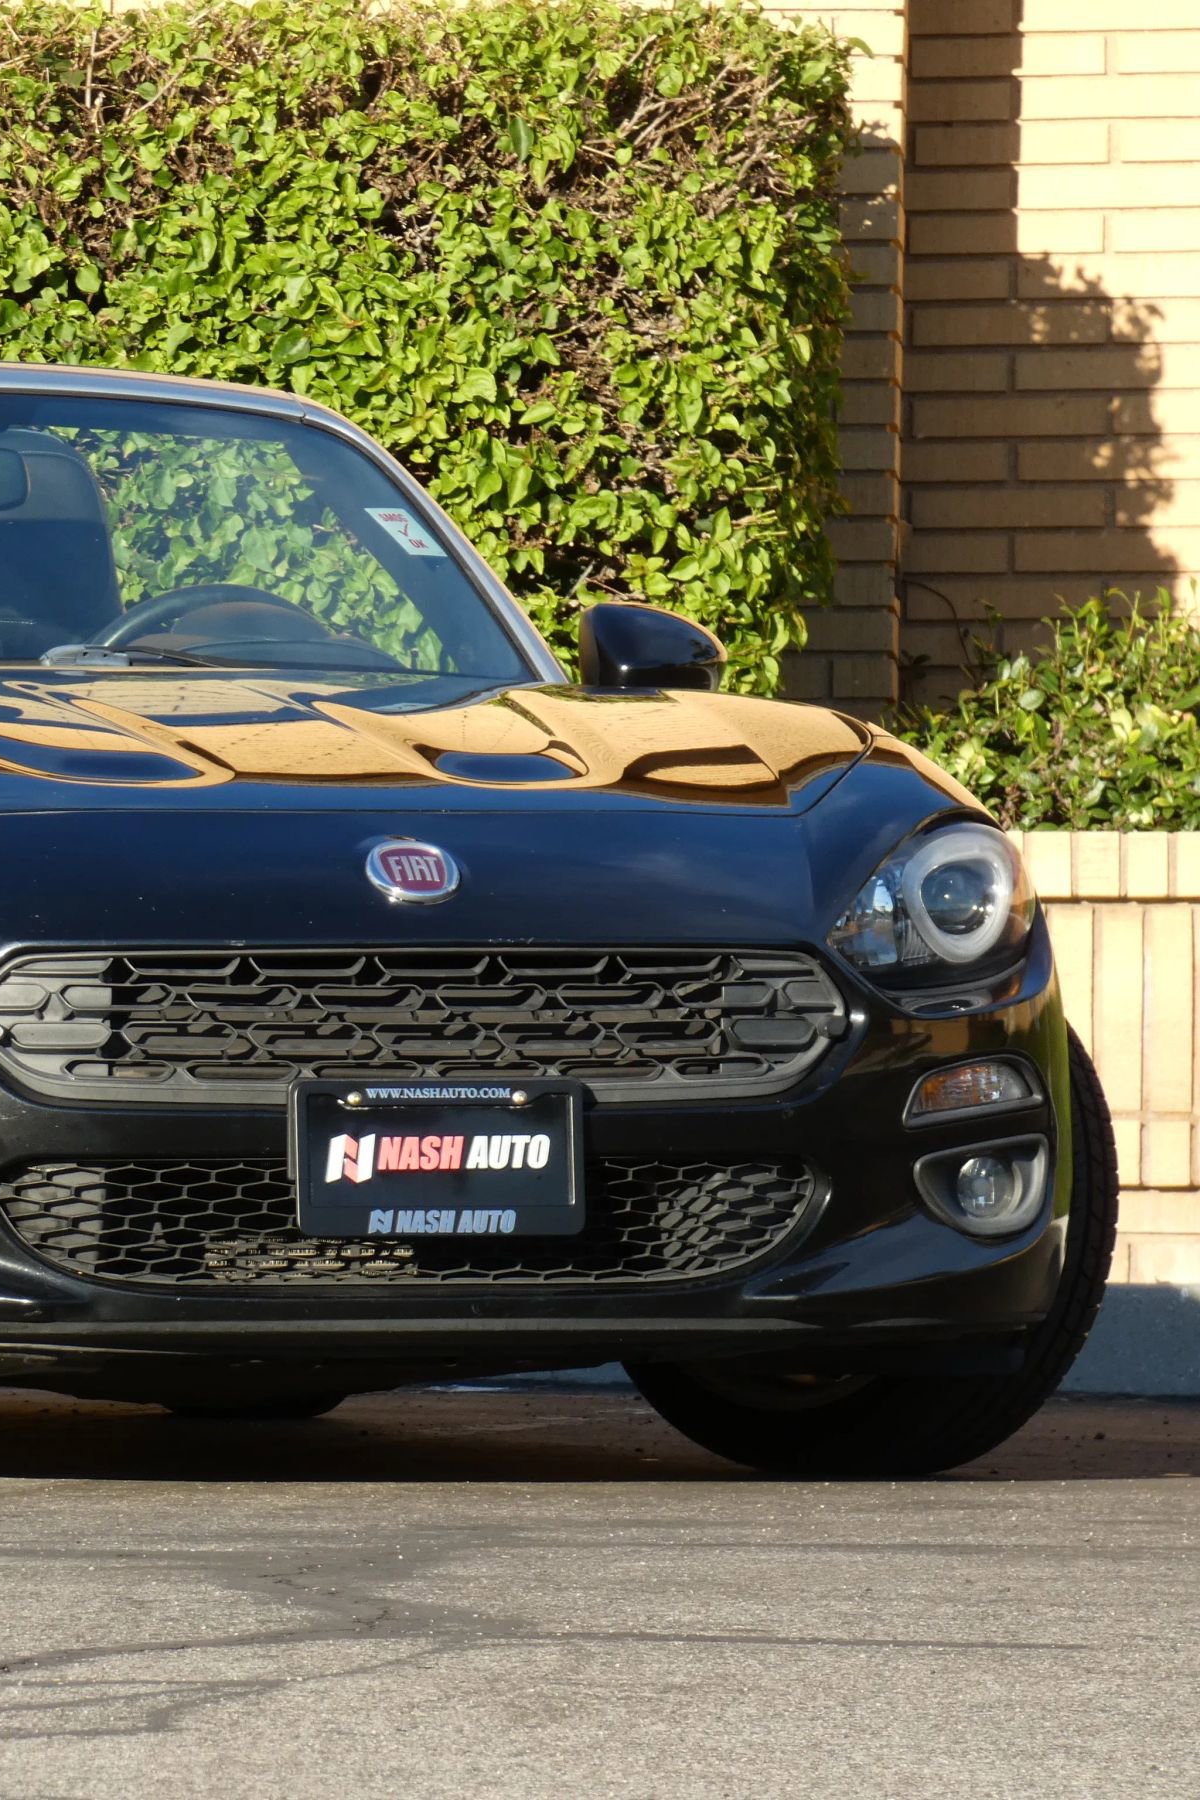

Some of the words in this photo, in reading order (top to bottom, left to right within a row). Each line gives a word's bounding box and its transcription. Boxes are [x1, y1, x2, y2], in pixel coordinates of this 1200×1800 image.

[386, 855, 440, 882] FIAT
[365, 1087, 511, 1099] WWW.NASHAUTO.COM
[377, 1136, 464, 1171] NASH
[466, 1134, 550, 1169] AUTO
[395, 1210, 456, 1233] NASH
[457, 1210, 517, 1233] AUTO
